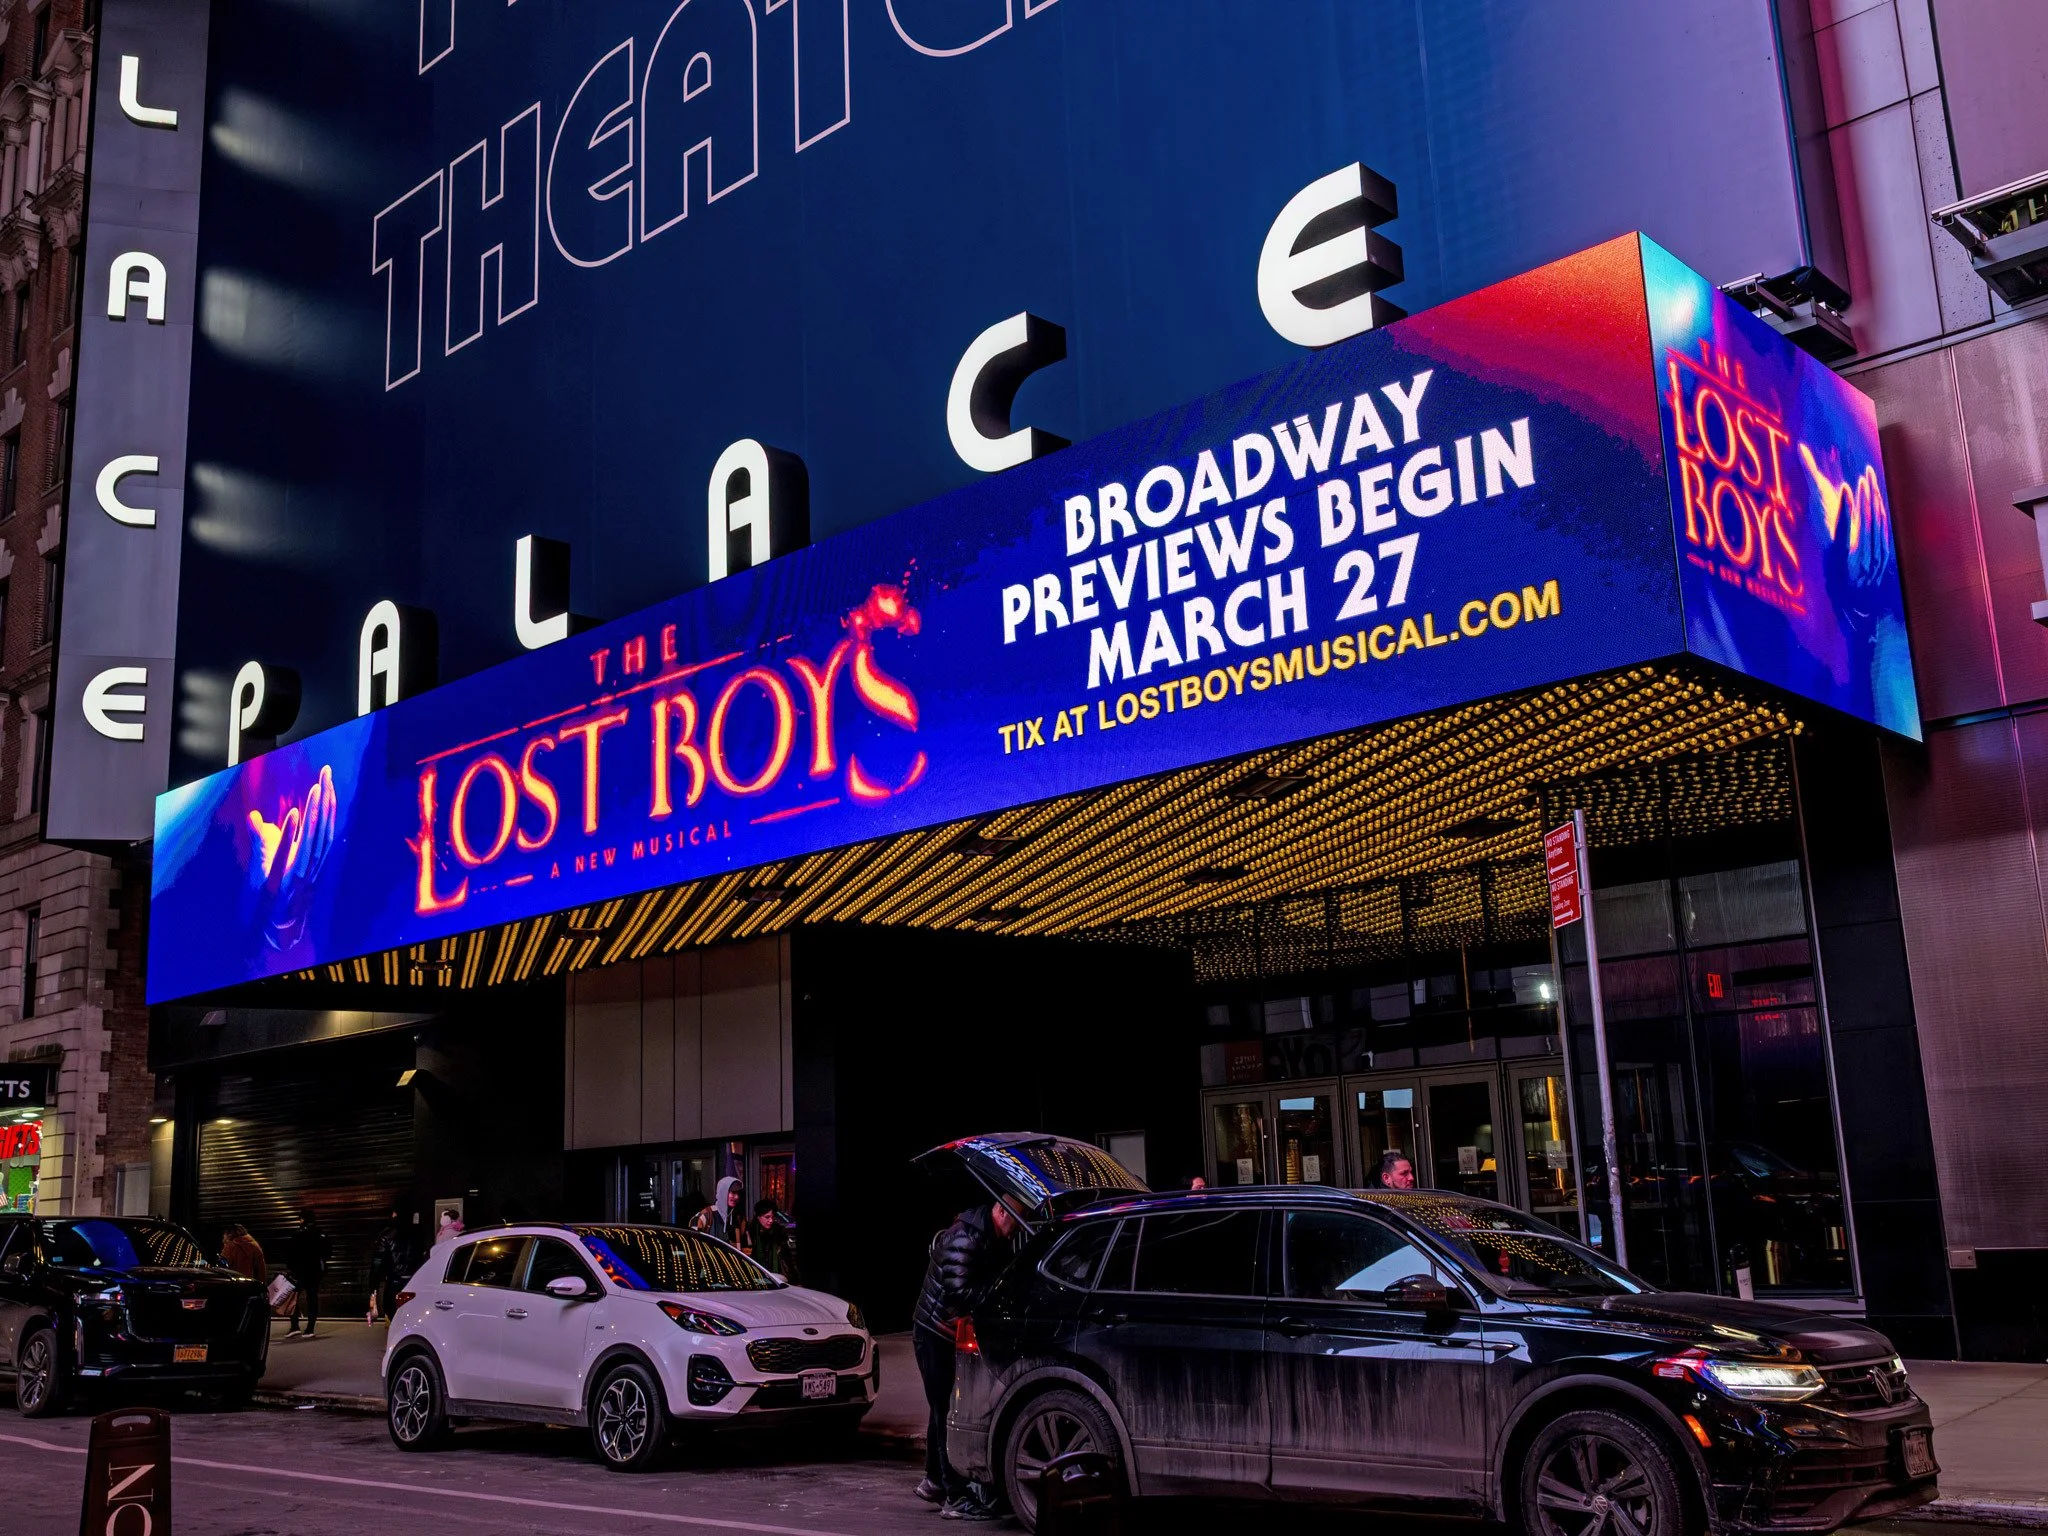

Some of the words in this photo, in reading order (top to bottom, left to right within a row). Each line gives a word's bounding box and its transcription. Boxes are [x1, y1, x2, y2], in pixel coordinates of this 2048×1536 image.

[371, 0, 1059, 392] THEAT
[1665, 359, 1789, 510] LOST
[1697, 337, 1744, 389] THE
[228, 161, 1375, 767] PALACE
[1001, 496, 1295, 644] PREVIEWS
[1317, 416, 1536, 548] BEGIN
[1064, 368, 1434, 557] BROADWAY
[1678, 454, 1804, 598] BOYS
[590, 623, 678, 685] THE
[998, 718, 1045, 755] TIX
[1053, 704, 1089, 742] AT
[1098, 579, 1561, 731] LOSTBOYSMUSICAL.COM
[1086, 567, 1309, 689] MARCH
[1333, 532, 1420, 622] 27
[408, 705, 630, 914] LOST
[647, 583, 929, 818] BOYS
[550, 861, 560, 879] A
[575, 847, 617, 873] NEW
[631, 820, 732, 861] MUSICAL
[104, 1463, 155, 1536] NO
